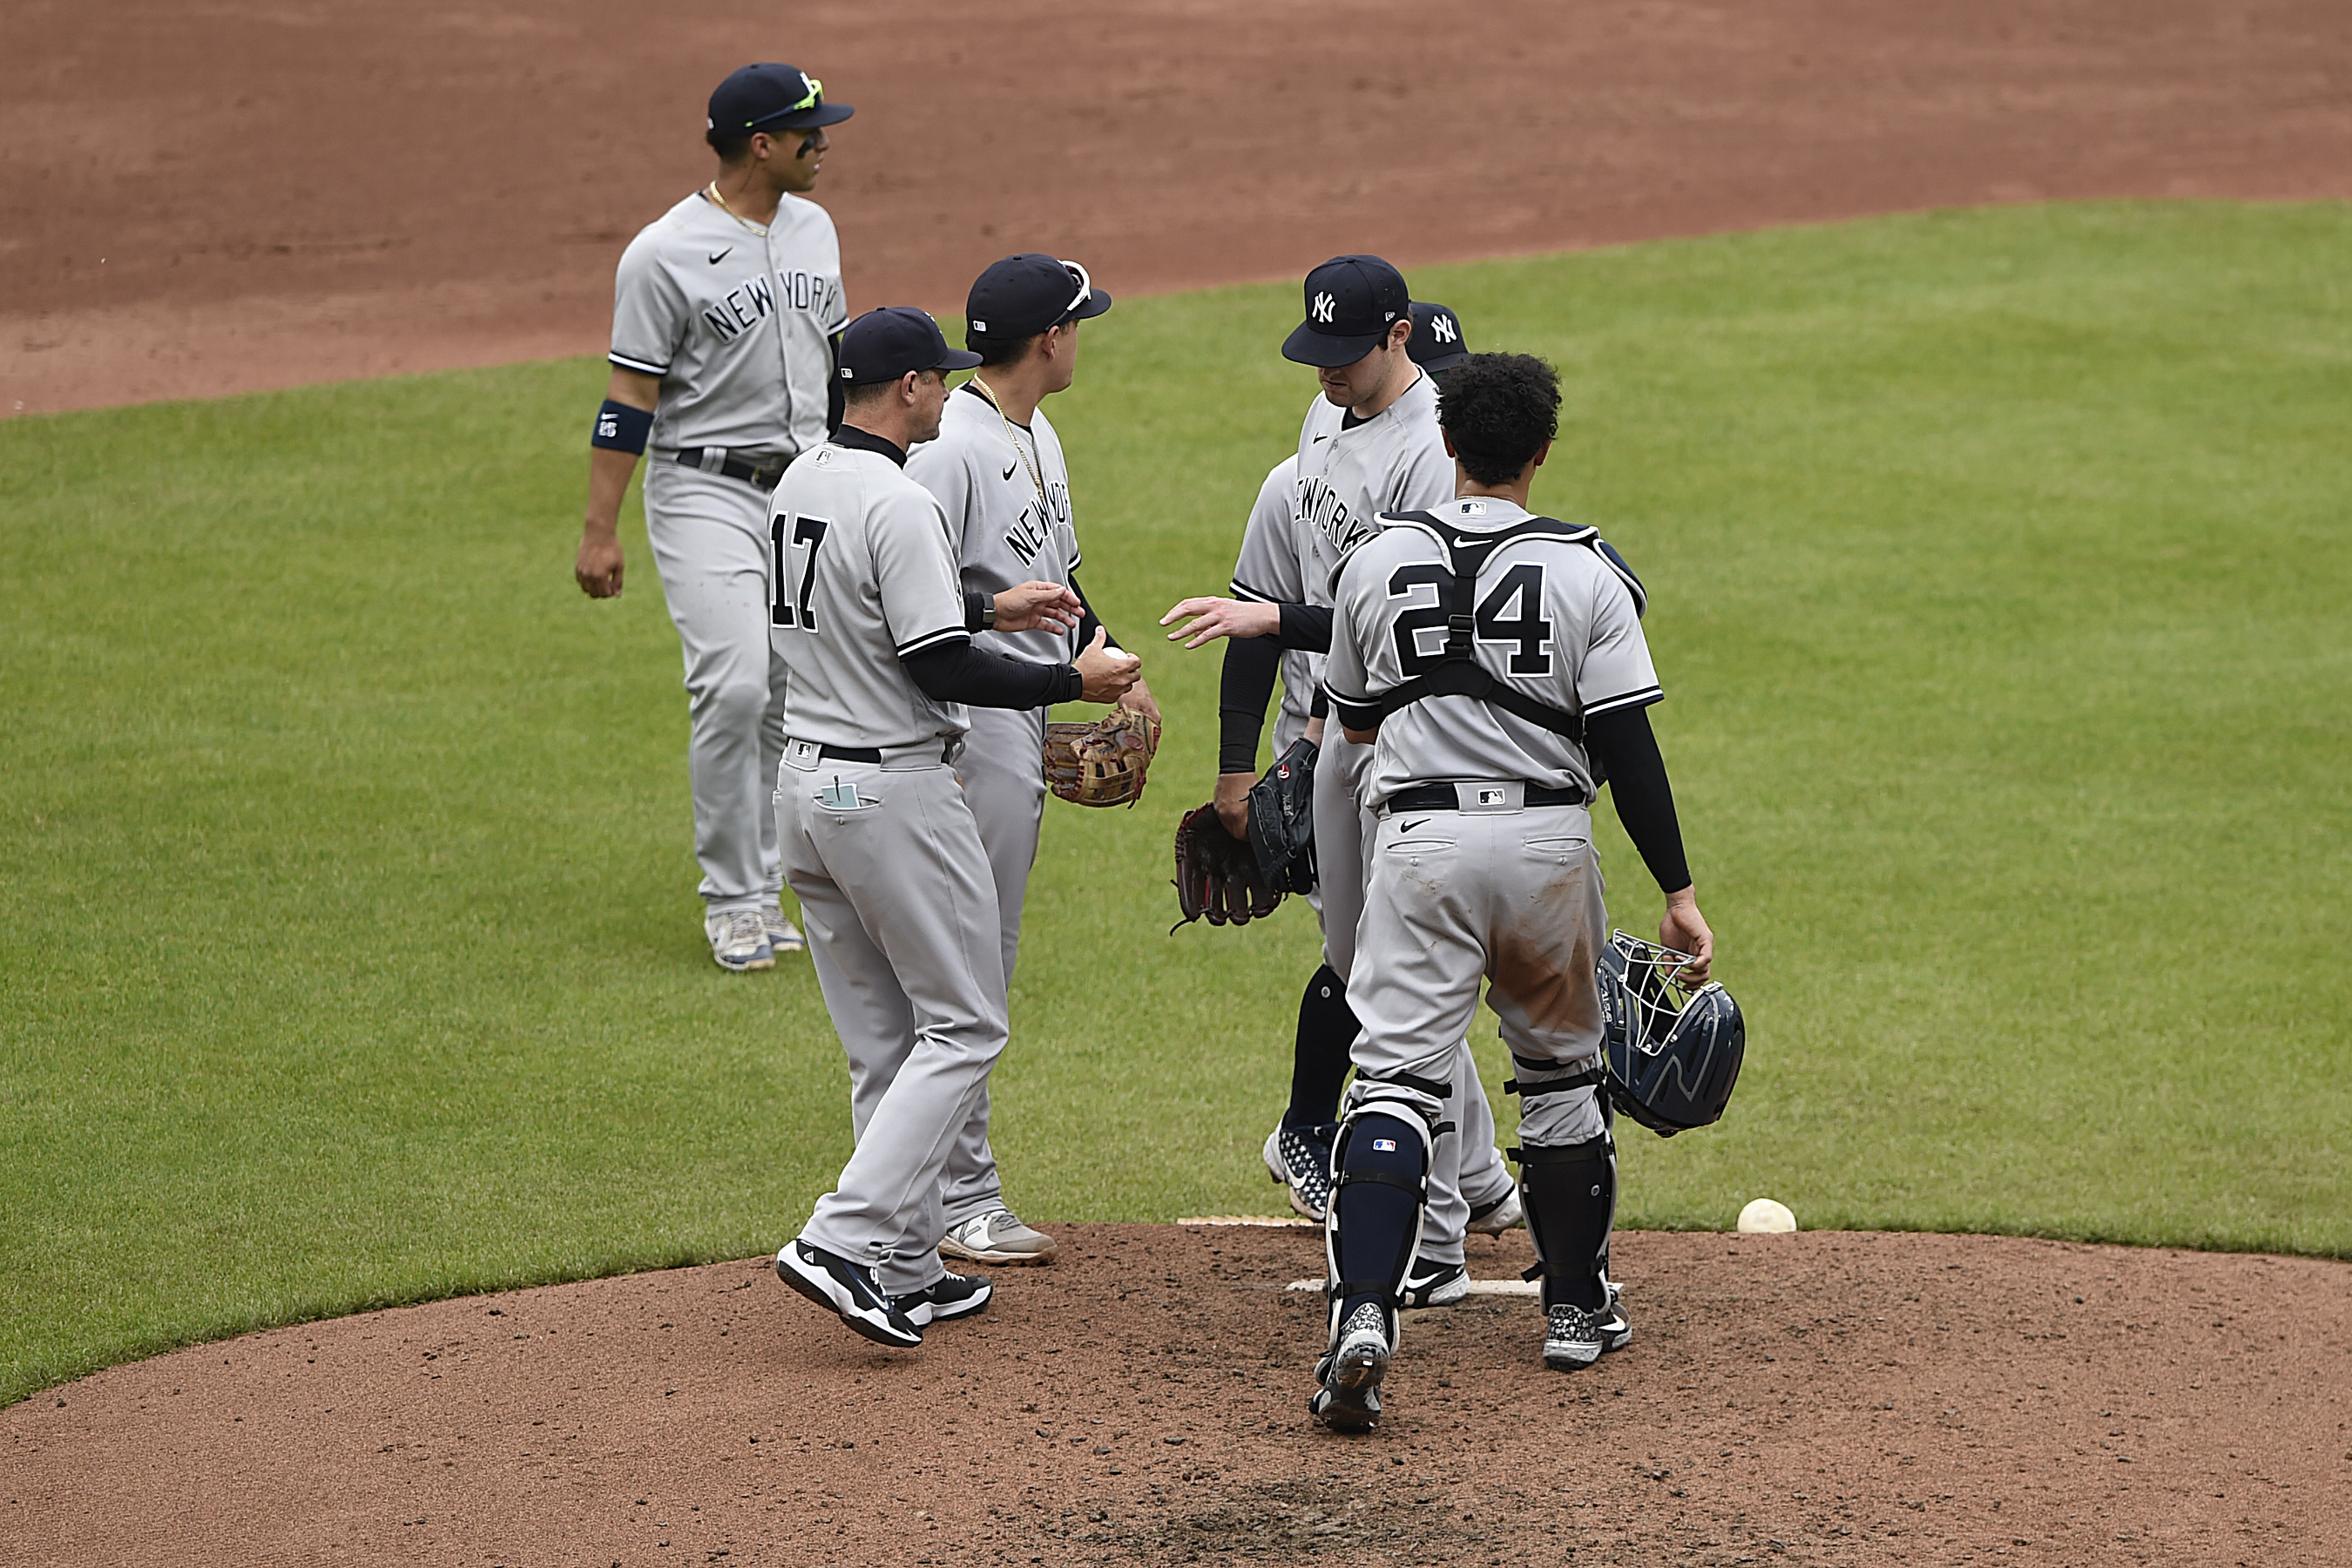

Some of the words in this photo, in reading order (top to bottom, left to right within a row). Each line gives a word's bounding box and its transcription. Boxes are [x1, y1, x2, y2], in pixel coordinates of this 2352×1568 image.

[702, 274, 774, 344] NEW
[777, 269, 839, 329] YORK
[1312, 291, 1336, 323] NY
[1430, 314, 1457, 343] NY
[1004, 497, 1052, 570] NEW
[770, 510, 832, 633] 17
[1384, 560, 1554, 680] 24
